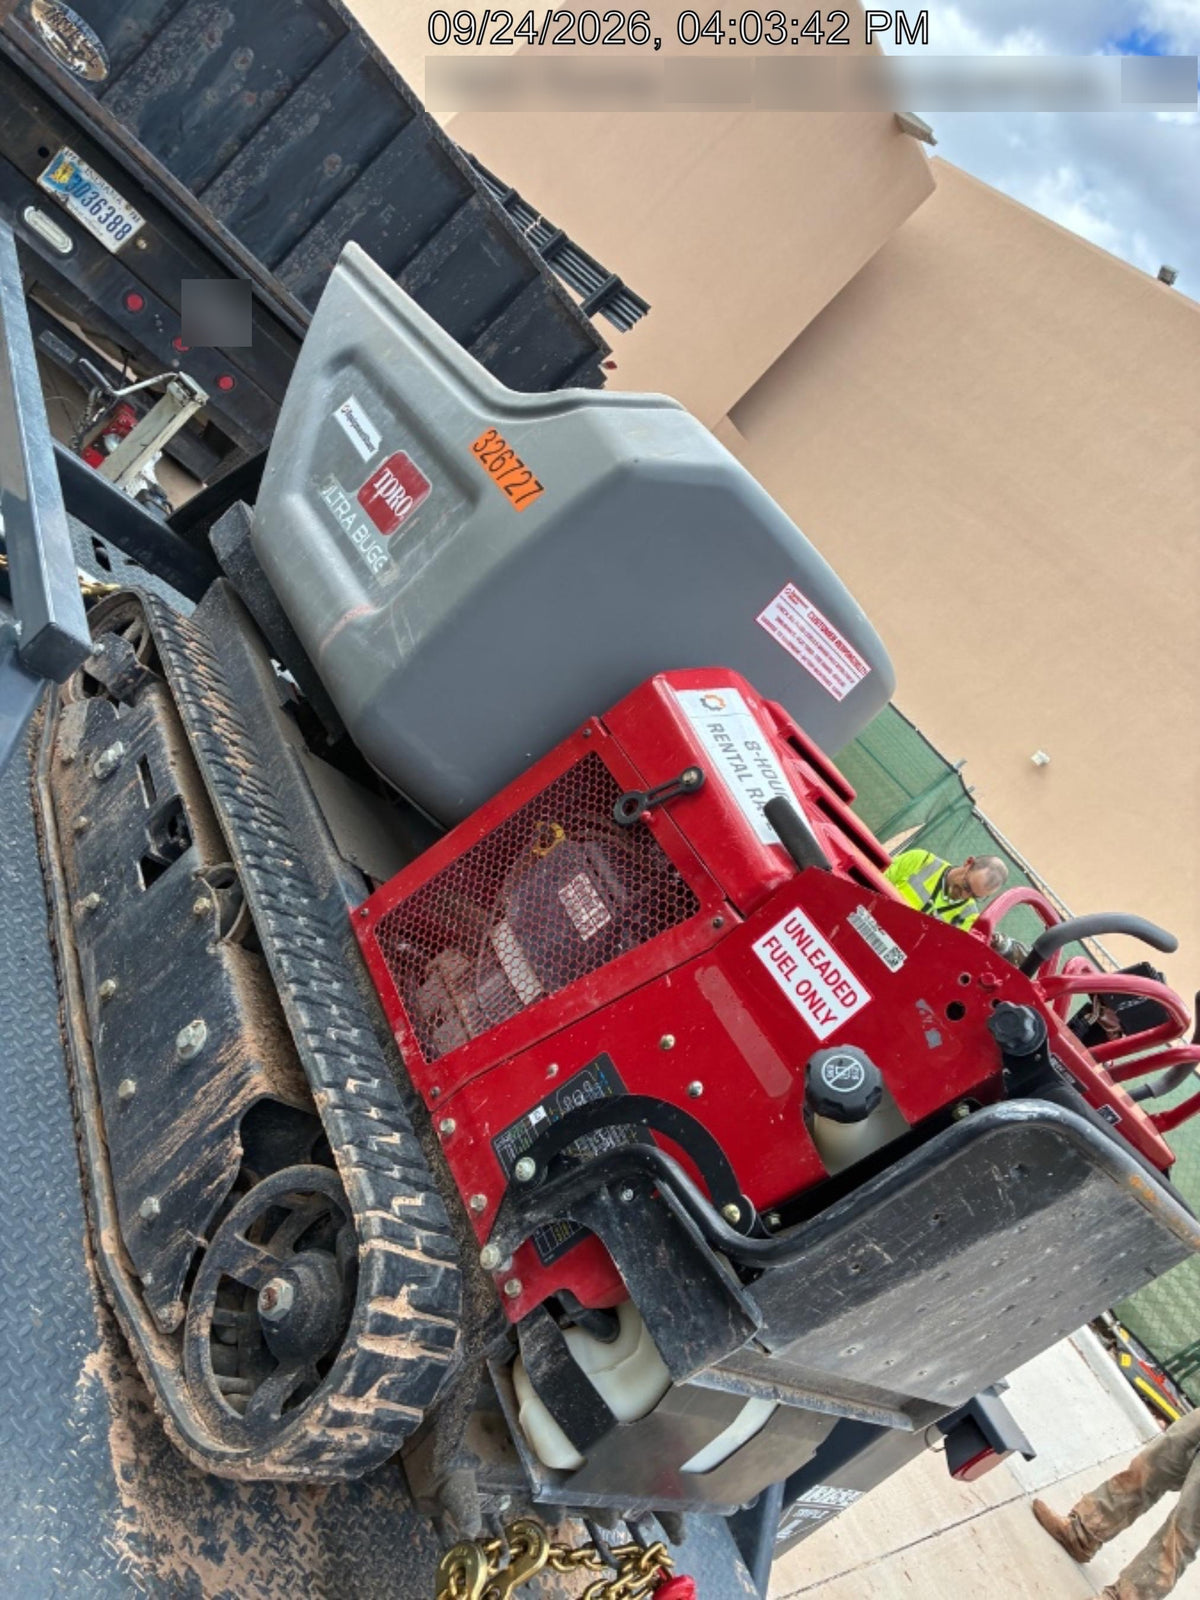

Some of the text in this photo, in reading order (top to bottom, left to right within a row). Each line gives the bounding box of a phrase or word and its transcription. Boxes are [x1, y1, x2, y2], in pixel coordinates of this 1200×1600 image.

[371, 467, 414, 518] TORO
[472, 429, 544, 504] 326727
[707, 723, 753, 783] RENTAL
[762, 935, 838, 1026] FUEL ONLY
[783, 916, 859, 1009] UNLEADED
